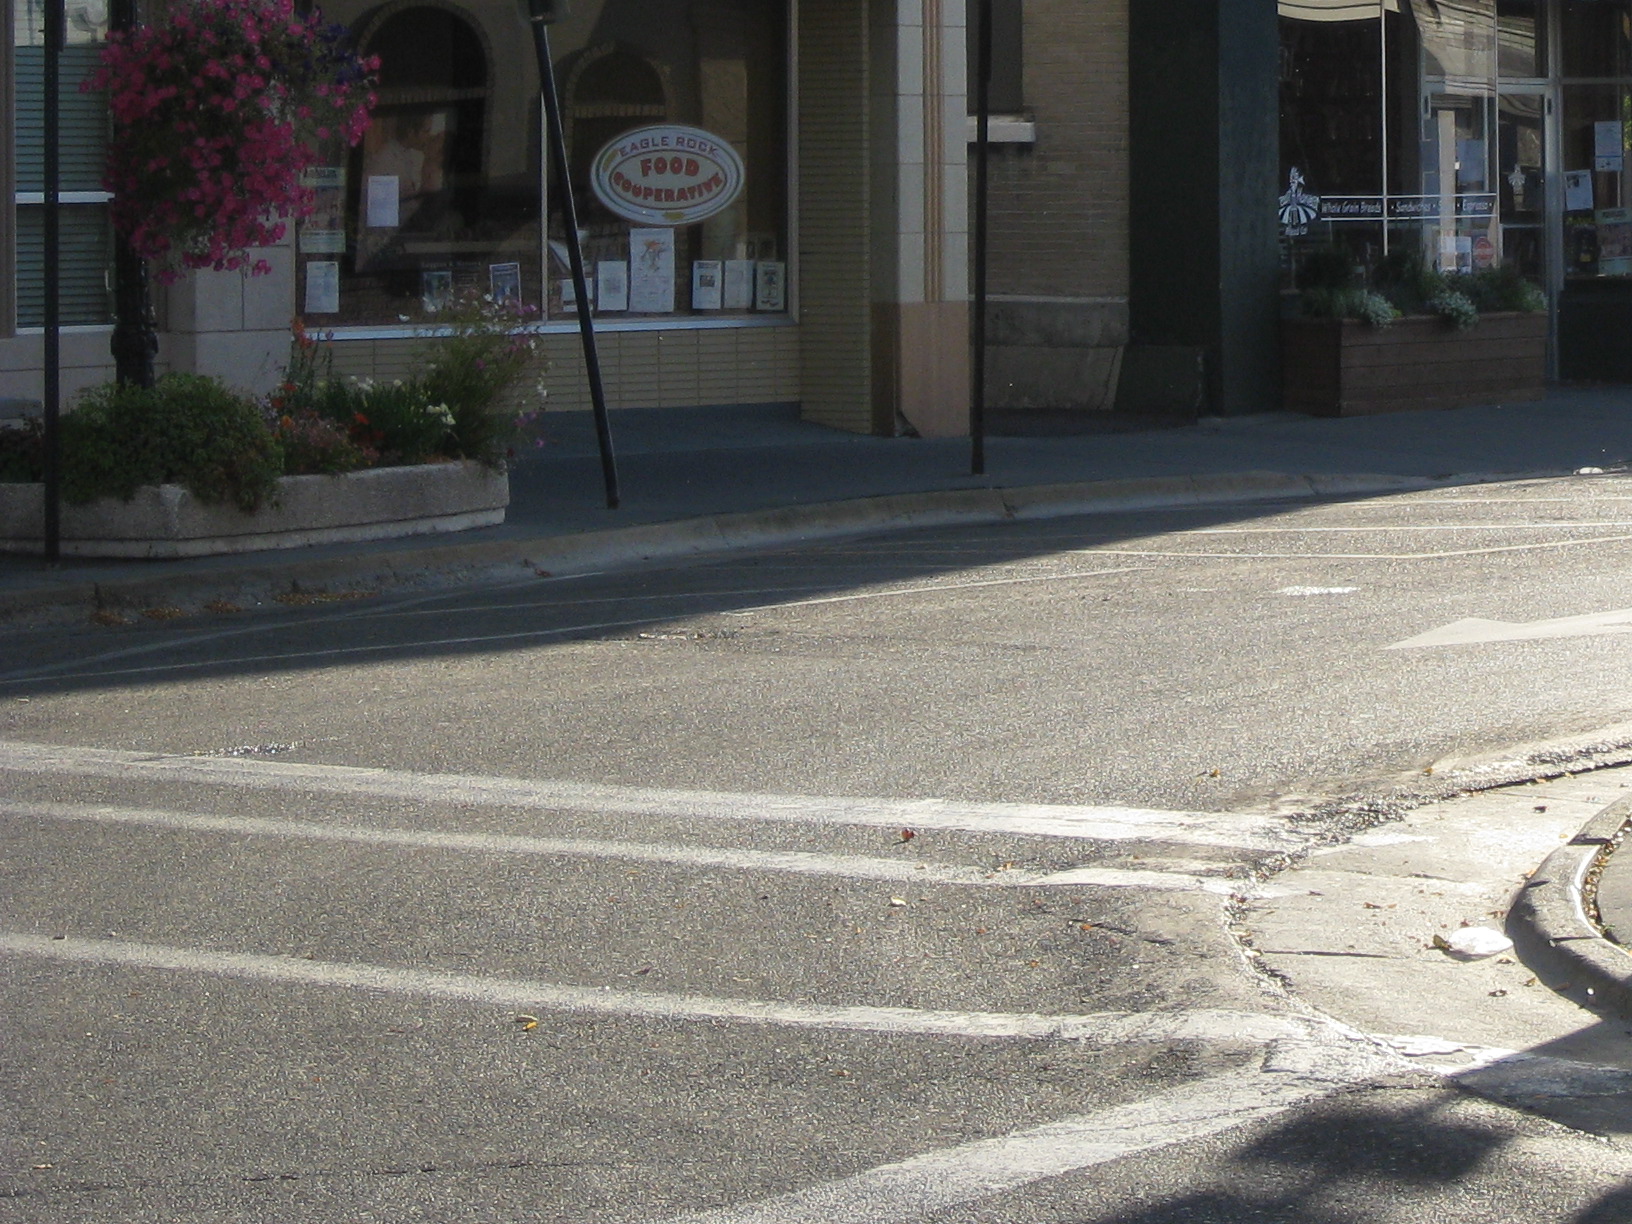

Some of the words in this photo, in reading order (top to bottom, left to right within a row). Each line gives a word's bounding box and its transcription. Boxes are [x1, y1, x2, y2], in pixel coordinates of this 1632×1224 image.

[618, 136, 670, 157] EAGLE
[676, 136, 719, 159] ROCK
[640, 156, 700, 177] FOOD
[613, 171, 724, 202] COOPERATIVE
